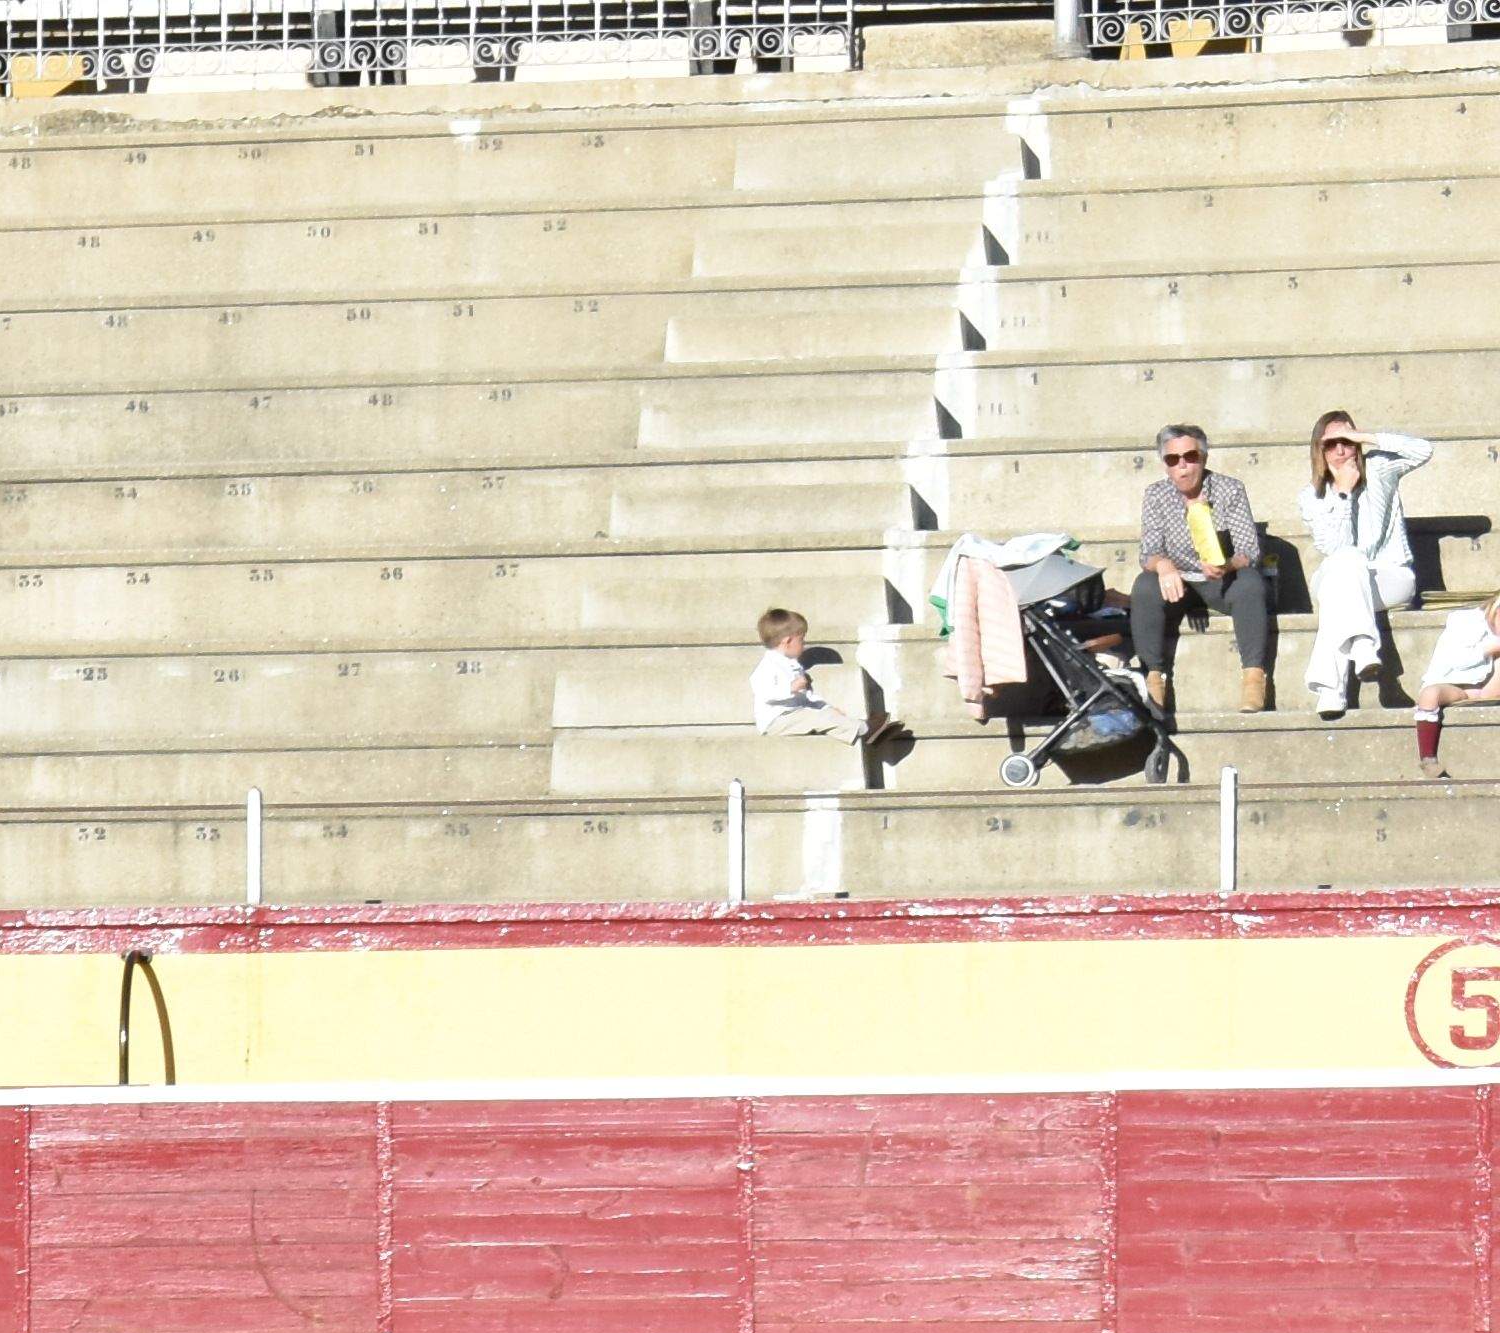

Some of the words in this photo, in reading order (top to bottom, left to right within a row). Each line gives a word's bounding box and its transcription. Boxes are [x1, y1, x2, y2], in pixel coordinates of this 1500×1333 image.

[125, 152, 147, 164] 49
[1403, 273, 1413, 285] 4
[1168, 282, 1178, 295] 2
[1144, 368, 1154, 381] 2
[1133, 456, 1144, 470] 2
[1449, 967, 1500, 1051] 5
